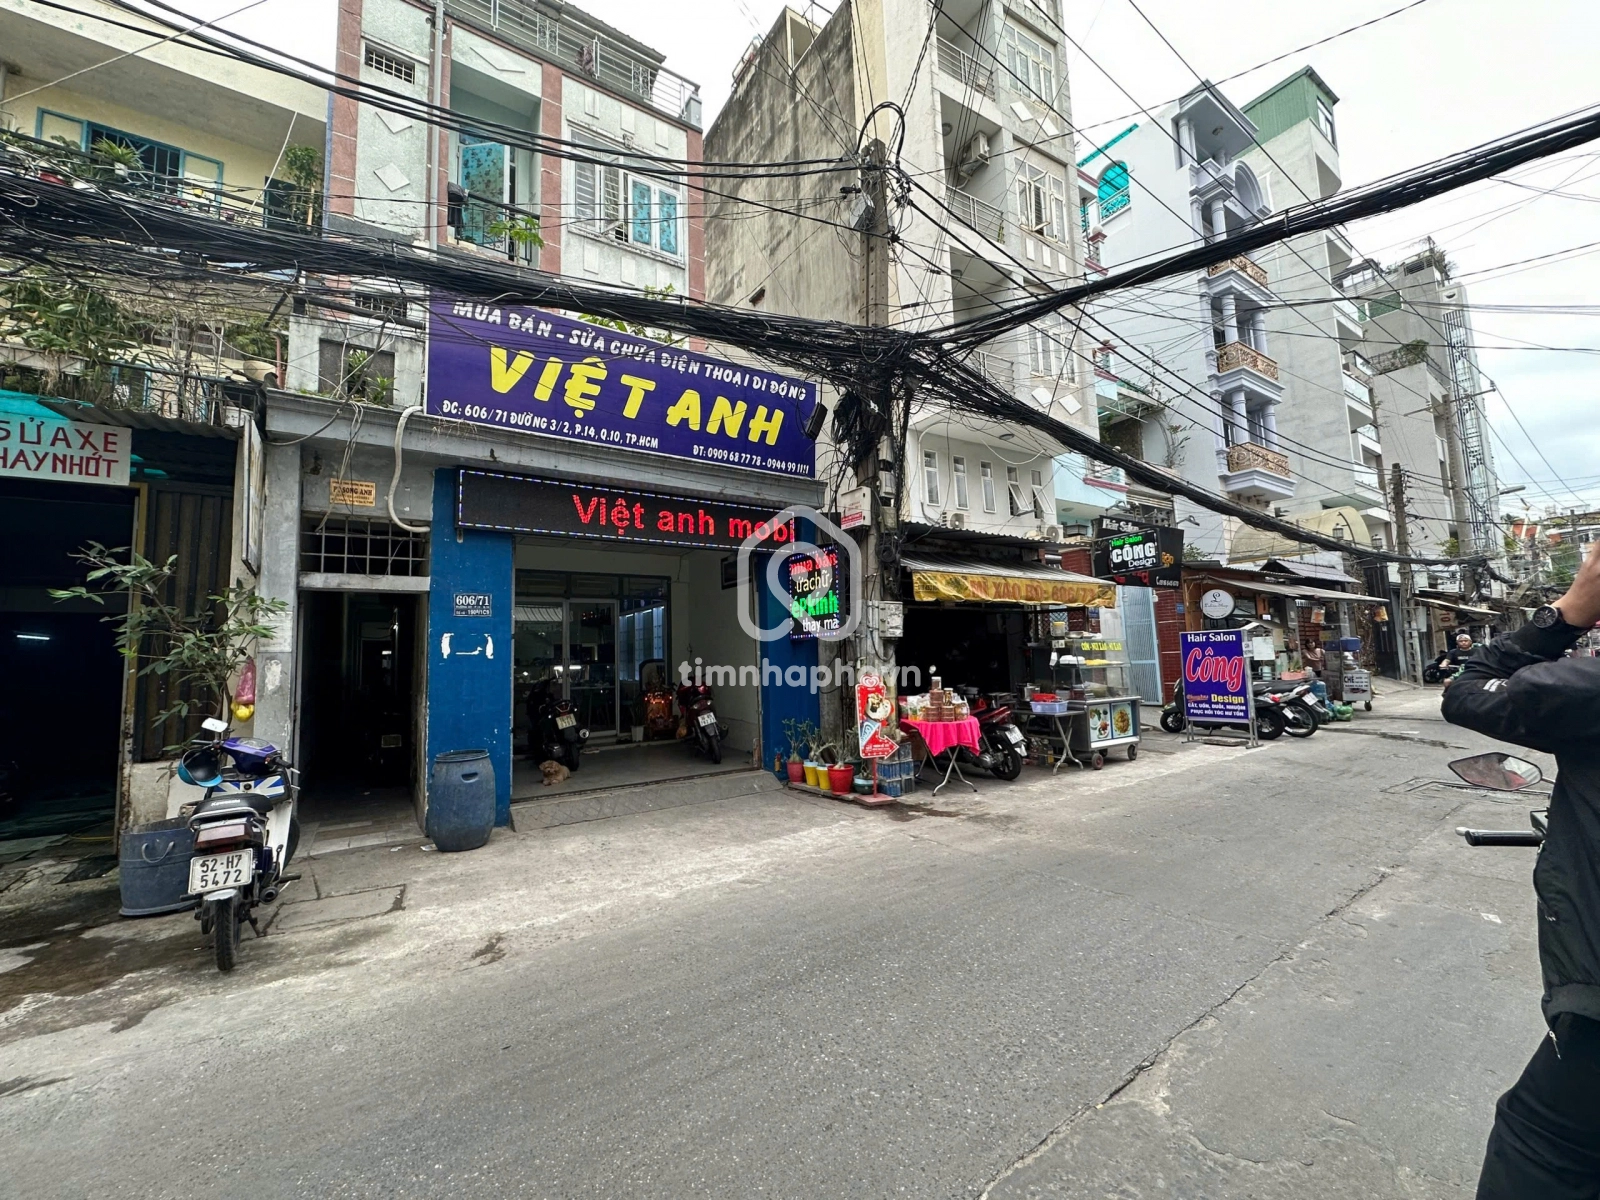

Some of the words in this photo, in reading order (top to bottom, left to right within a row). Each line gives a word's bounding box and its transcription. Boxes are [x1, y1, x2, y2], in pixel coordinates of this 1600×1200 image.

[453, 301, 502, 325] MUA
[509, 313, 553, 338] BÁN
[568, 327, 605, 351] SỬA
[610, 339, 656, 364] CHỮA
[661, 352, 700, 375] ĐIỆN
[704, 364, 749, 388] THOẠI
[752, 377, 767, 392] DI
[770, 379, 806, 401] ĐỘNG
[490, 344, 656, 420] VIỆT
[666, 389, 784, 446] ANH
[442, 400, 462, 415] ĐC:
[464, 404, 507, 423] 606/71
[509, 411, 548, 430] ĐƯỜNG
[625, 433, 659, 449] TP.HCM
[707, 447, 727, 461] 0909
[729, 451, 739, 462] 68
[740, 453, 750, 464] 77
[767, 458, 785, 470] 0944
[572, 494, 645, 535] Việt
[657, 509, 715, 536] anh
[1111, 538, 1124, 547] Hair
[1125, 535, 1143, 544] Salon
[1112, 542, 1156, 563] CÔNG
[1128, 557, 1157, 567] Design
[790, 560, 813, 575] mua
[456, 595, 490, 606] 606/71
[802, 617, 821, 632] thay
[1187, 633, 1207, 642] Hair
[1209, 633, 1236, 642] Salon
[1186, 647, 1244, 692] Công
[1211, 694, 1244, 704] Design
[200, 868, 242, 889] 5472
